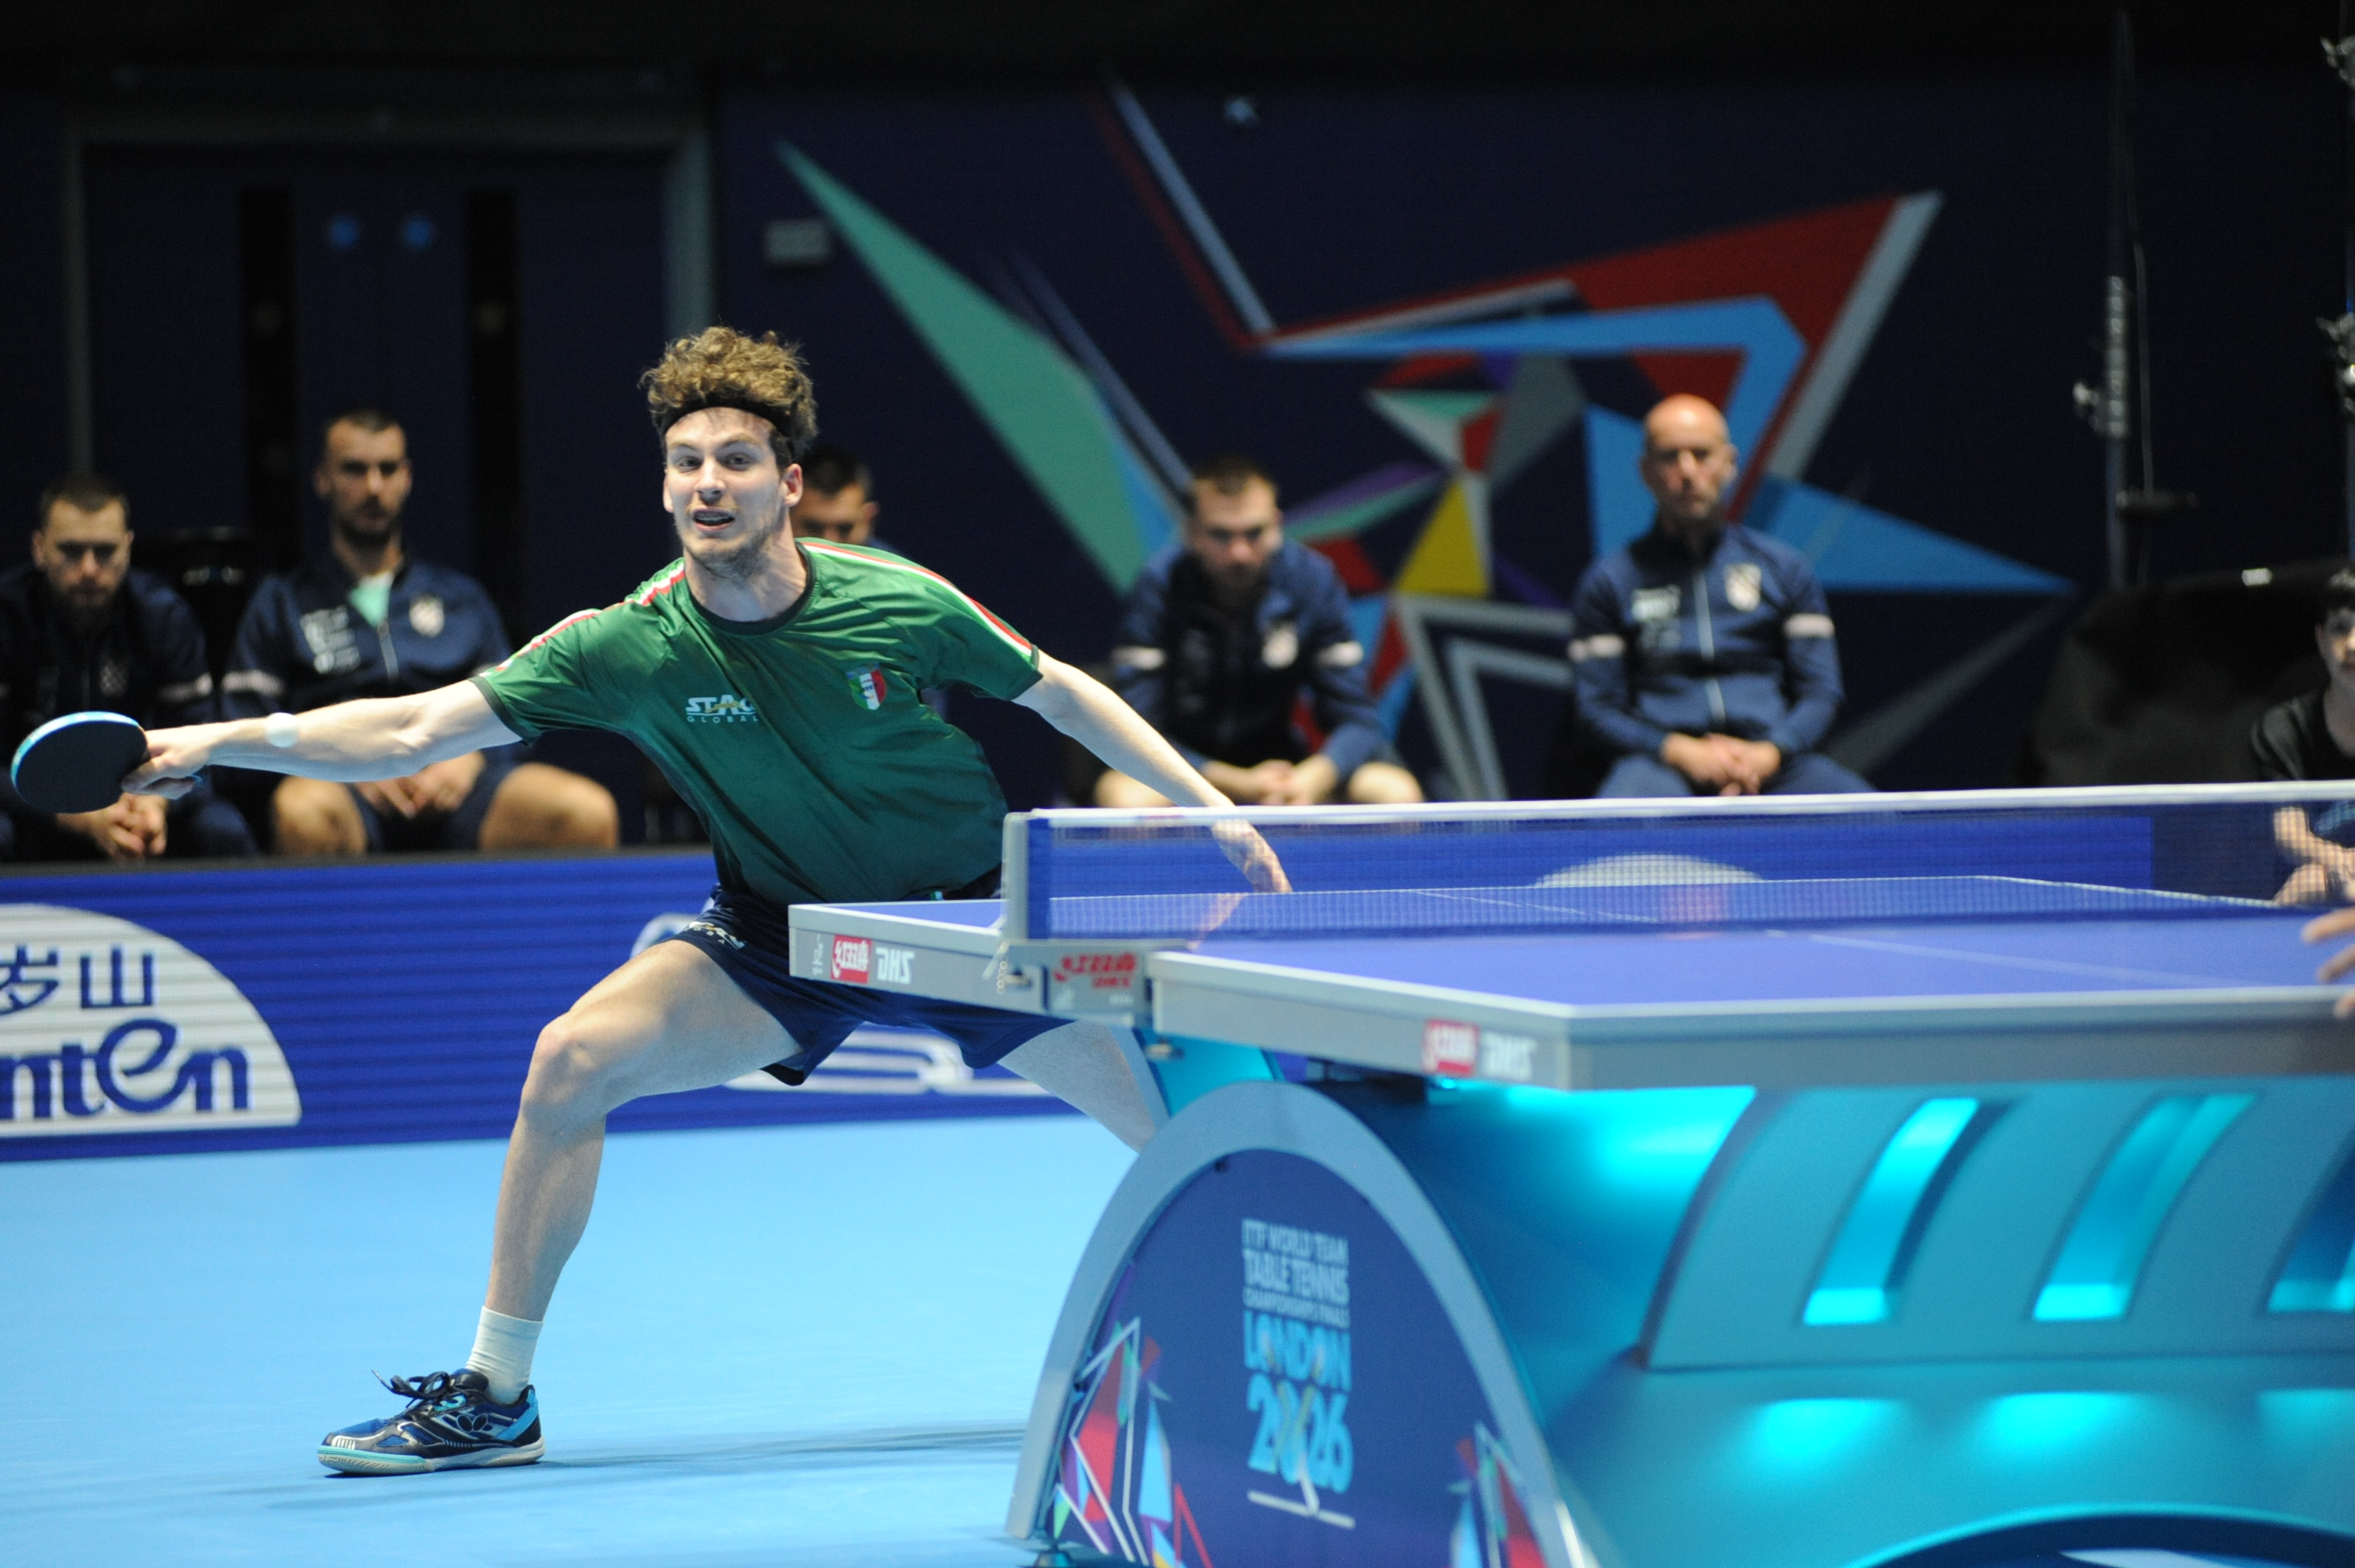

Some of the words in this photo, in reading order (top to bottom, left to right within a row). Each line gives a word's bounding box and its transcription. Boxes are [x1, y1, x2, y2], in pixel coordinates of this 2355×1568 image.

[686, 715, 759, 723] GLOBAL
[875, 945, 916, 985] DHS
[1243, 1247, 1289, 1293] TABLE
[1291, 1258, 1350, 1305] TENNIS
[1243, 1310, 1352, 1392] LONDON
[1247, 1371, 1354, 1494] 2026
